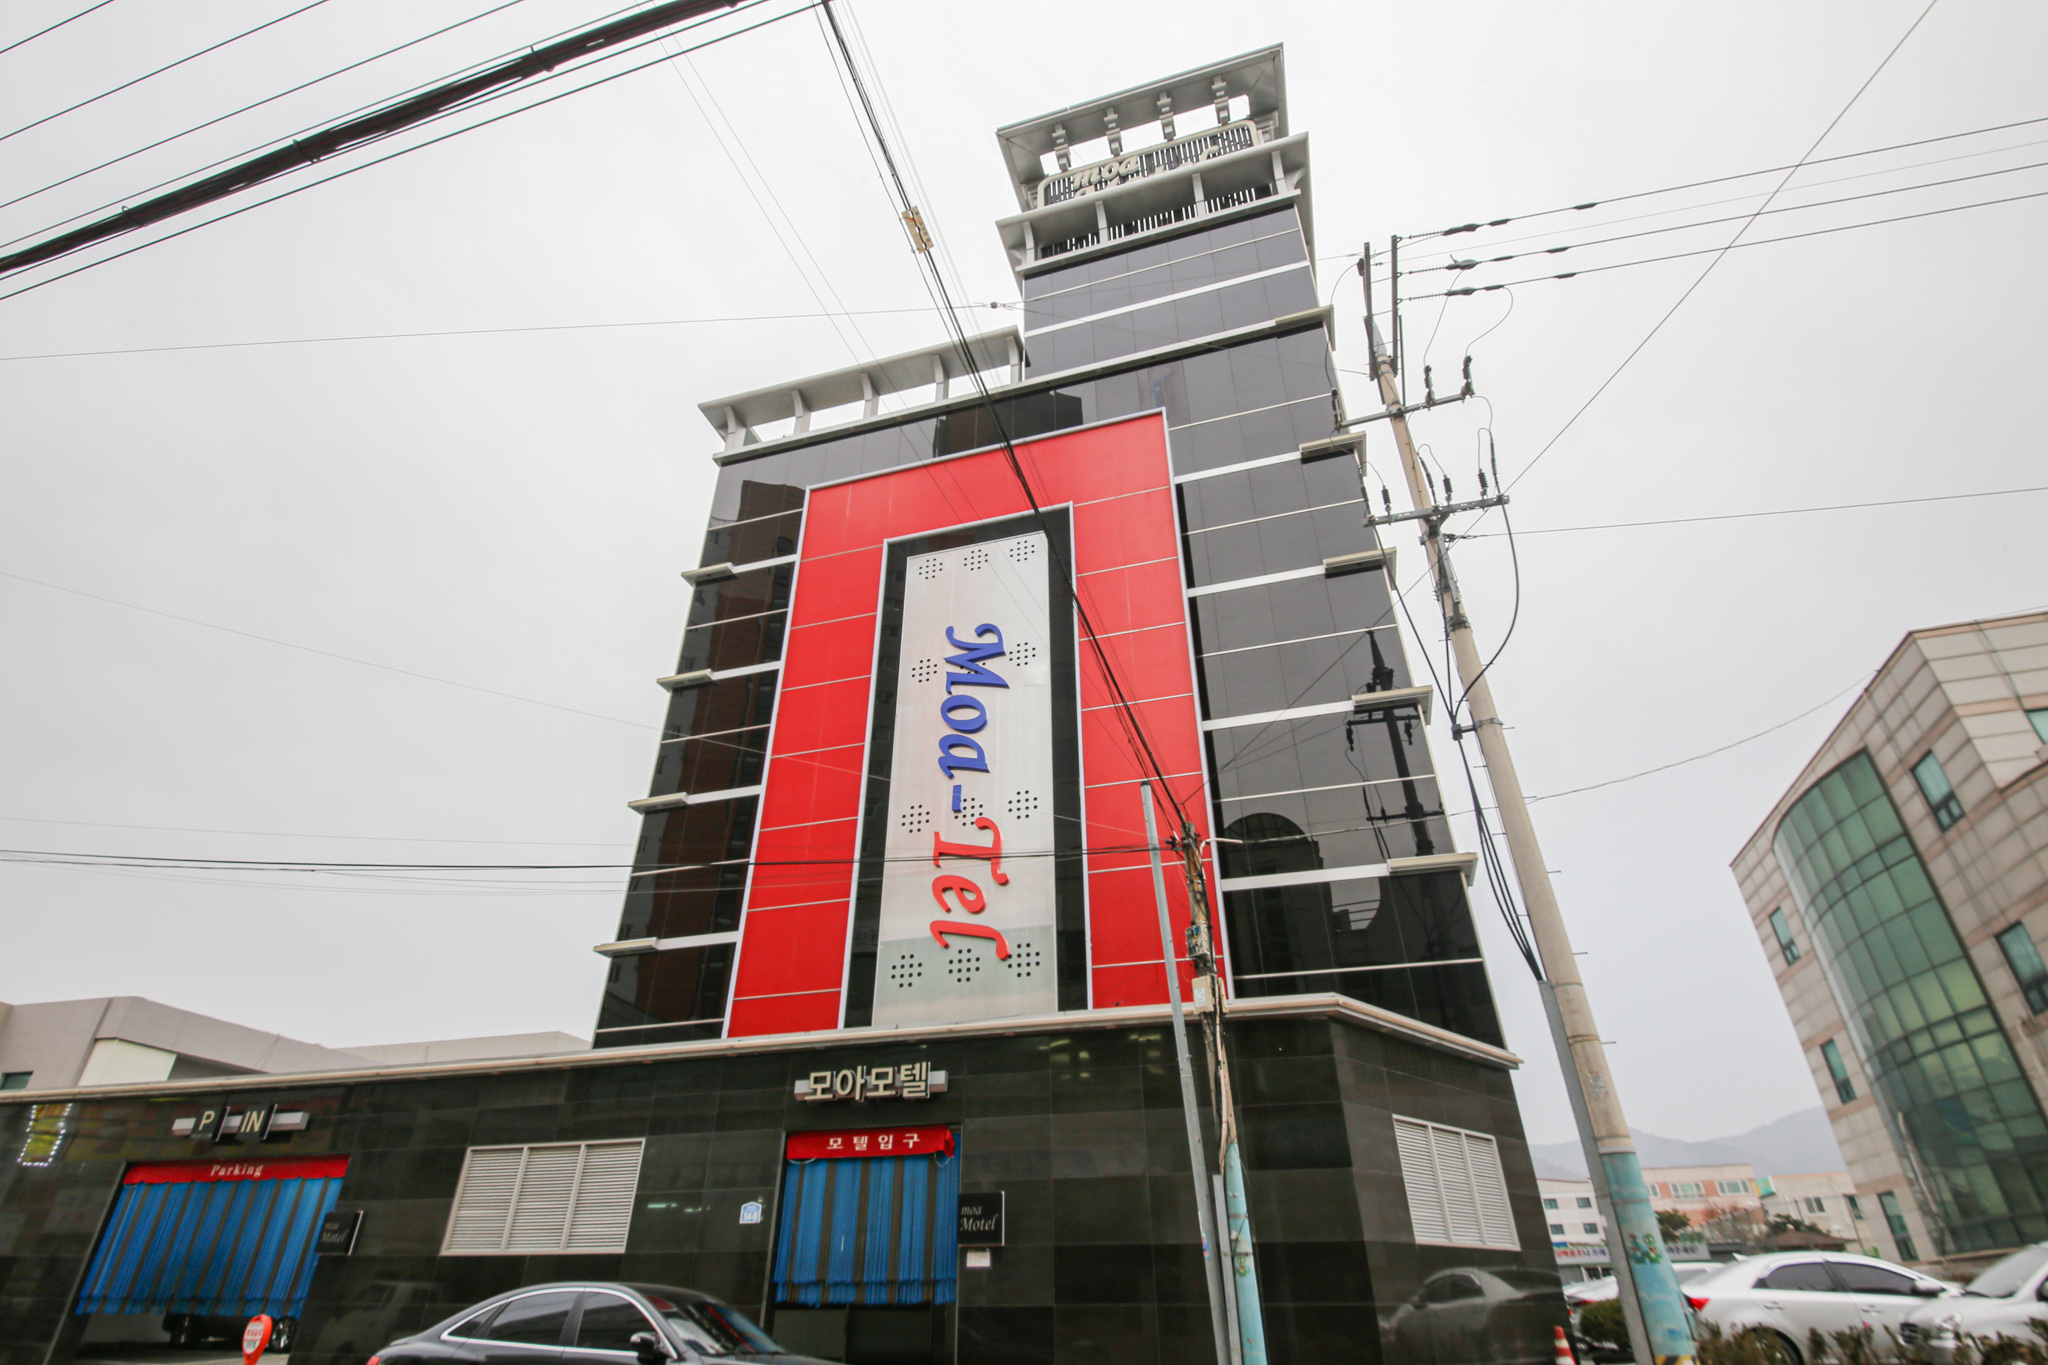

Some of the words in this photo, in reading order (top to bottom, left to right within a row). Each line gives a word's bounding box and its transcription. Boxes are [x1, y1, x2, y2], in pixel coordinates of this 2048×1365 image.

[1073, 155, 1139, 190] moa
[804, 1061, 928, 1101] 모아모텔
[198, 1110, 216, 1132] P
[239, 1109, 266, 1133] IN
[826, 1133, 921, 1151] 모텔입구
[209, 1163, 265, 1178] Parking
[961, 1205, 983, 1216] moa
[960, 1213, 1000, 1232] Motel
